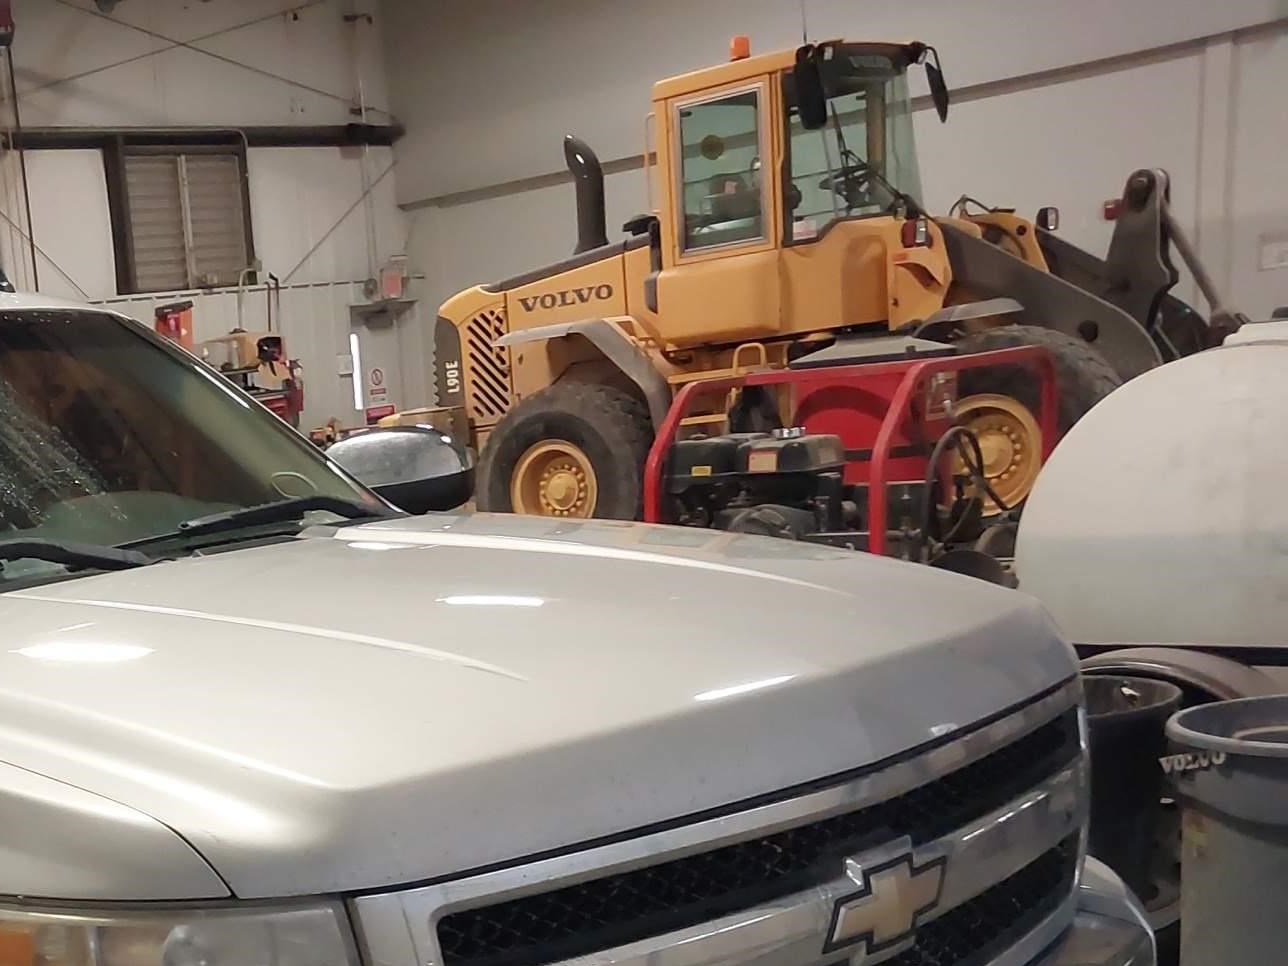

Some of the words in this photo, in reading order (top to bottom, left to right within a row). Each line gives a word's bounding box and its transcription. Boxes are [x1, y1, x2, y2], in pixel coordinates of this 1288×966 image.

[518, 284, 613, 312] VOLVO
[445, 361, 460, 393] L90E
[1158, 752, 1226, 774] VOLVO
